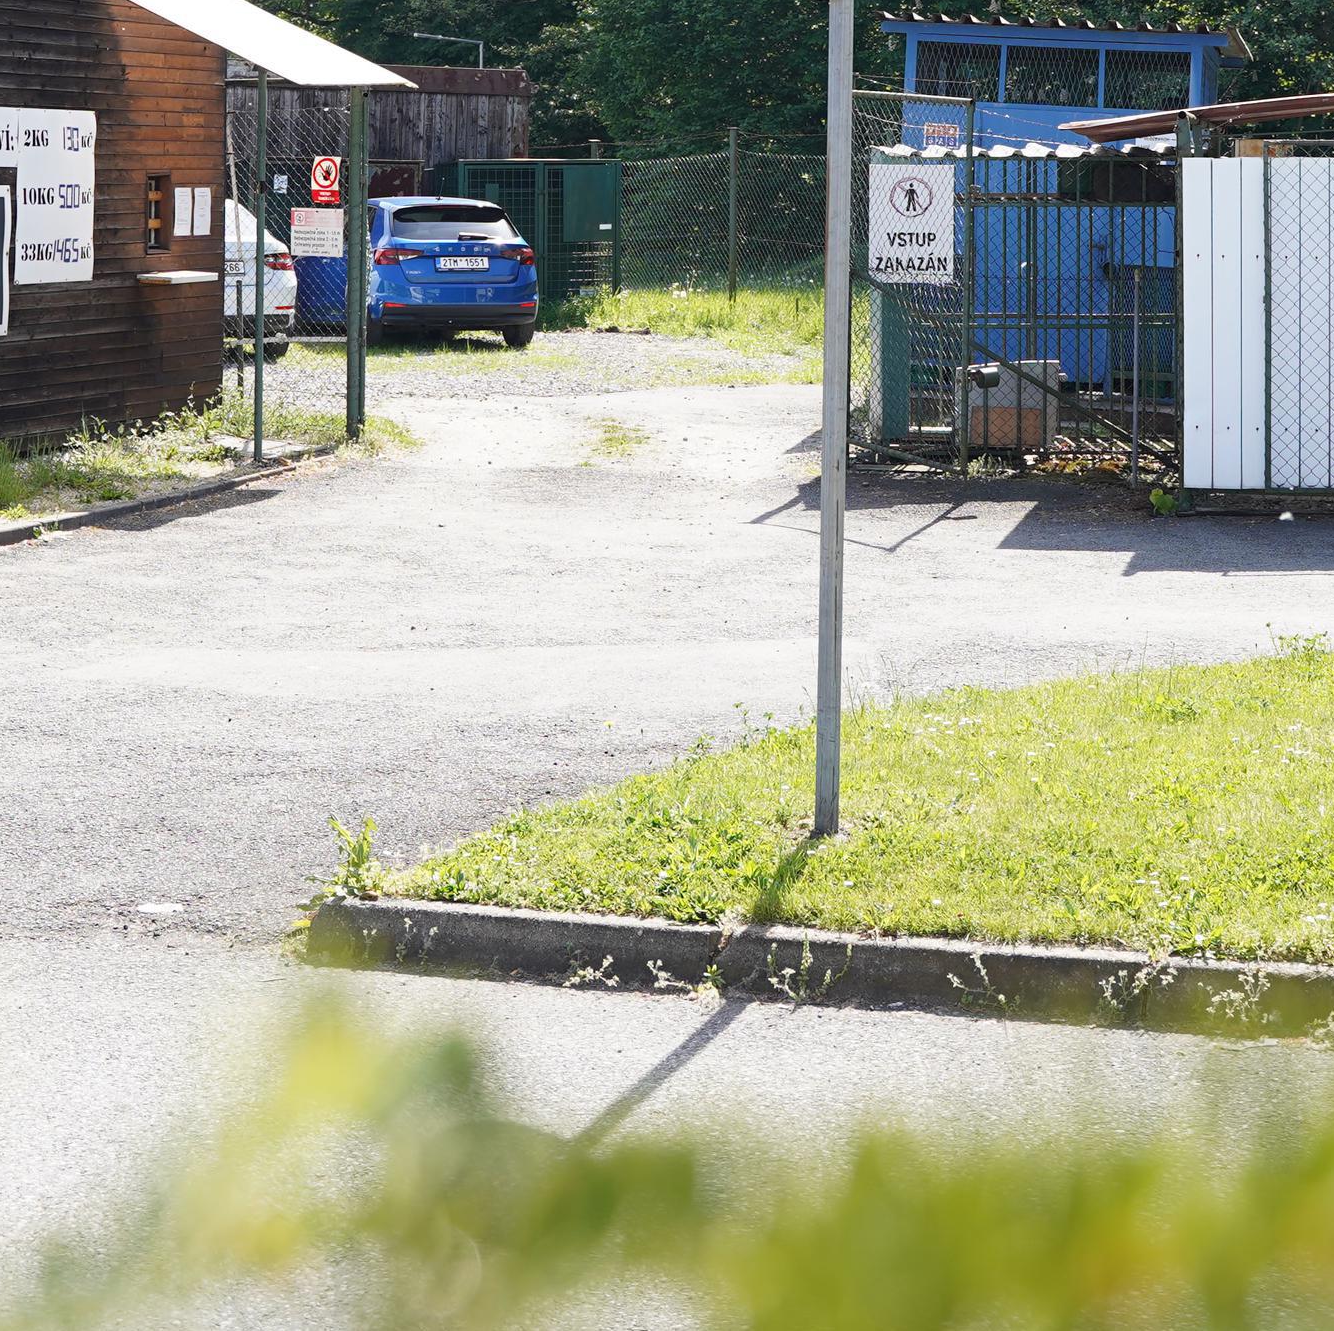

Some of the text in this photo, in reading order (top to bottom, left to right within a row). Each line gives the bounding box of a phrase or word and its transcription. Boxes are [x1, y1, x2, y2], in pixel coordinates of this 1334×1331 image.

[24, 129, 49, 147] 2KG
[63, 126, 80, 152] 130
[22, 187, 55, 205] 10KG
[58, 183, 80, 208] 500
[21, 243, 52, 261] 33KG
[53, 238, 79, 263] 1465
[887, 232, 936, 247] VSTUP
